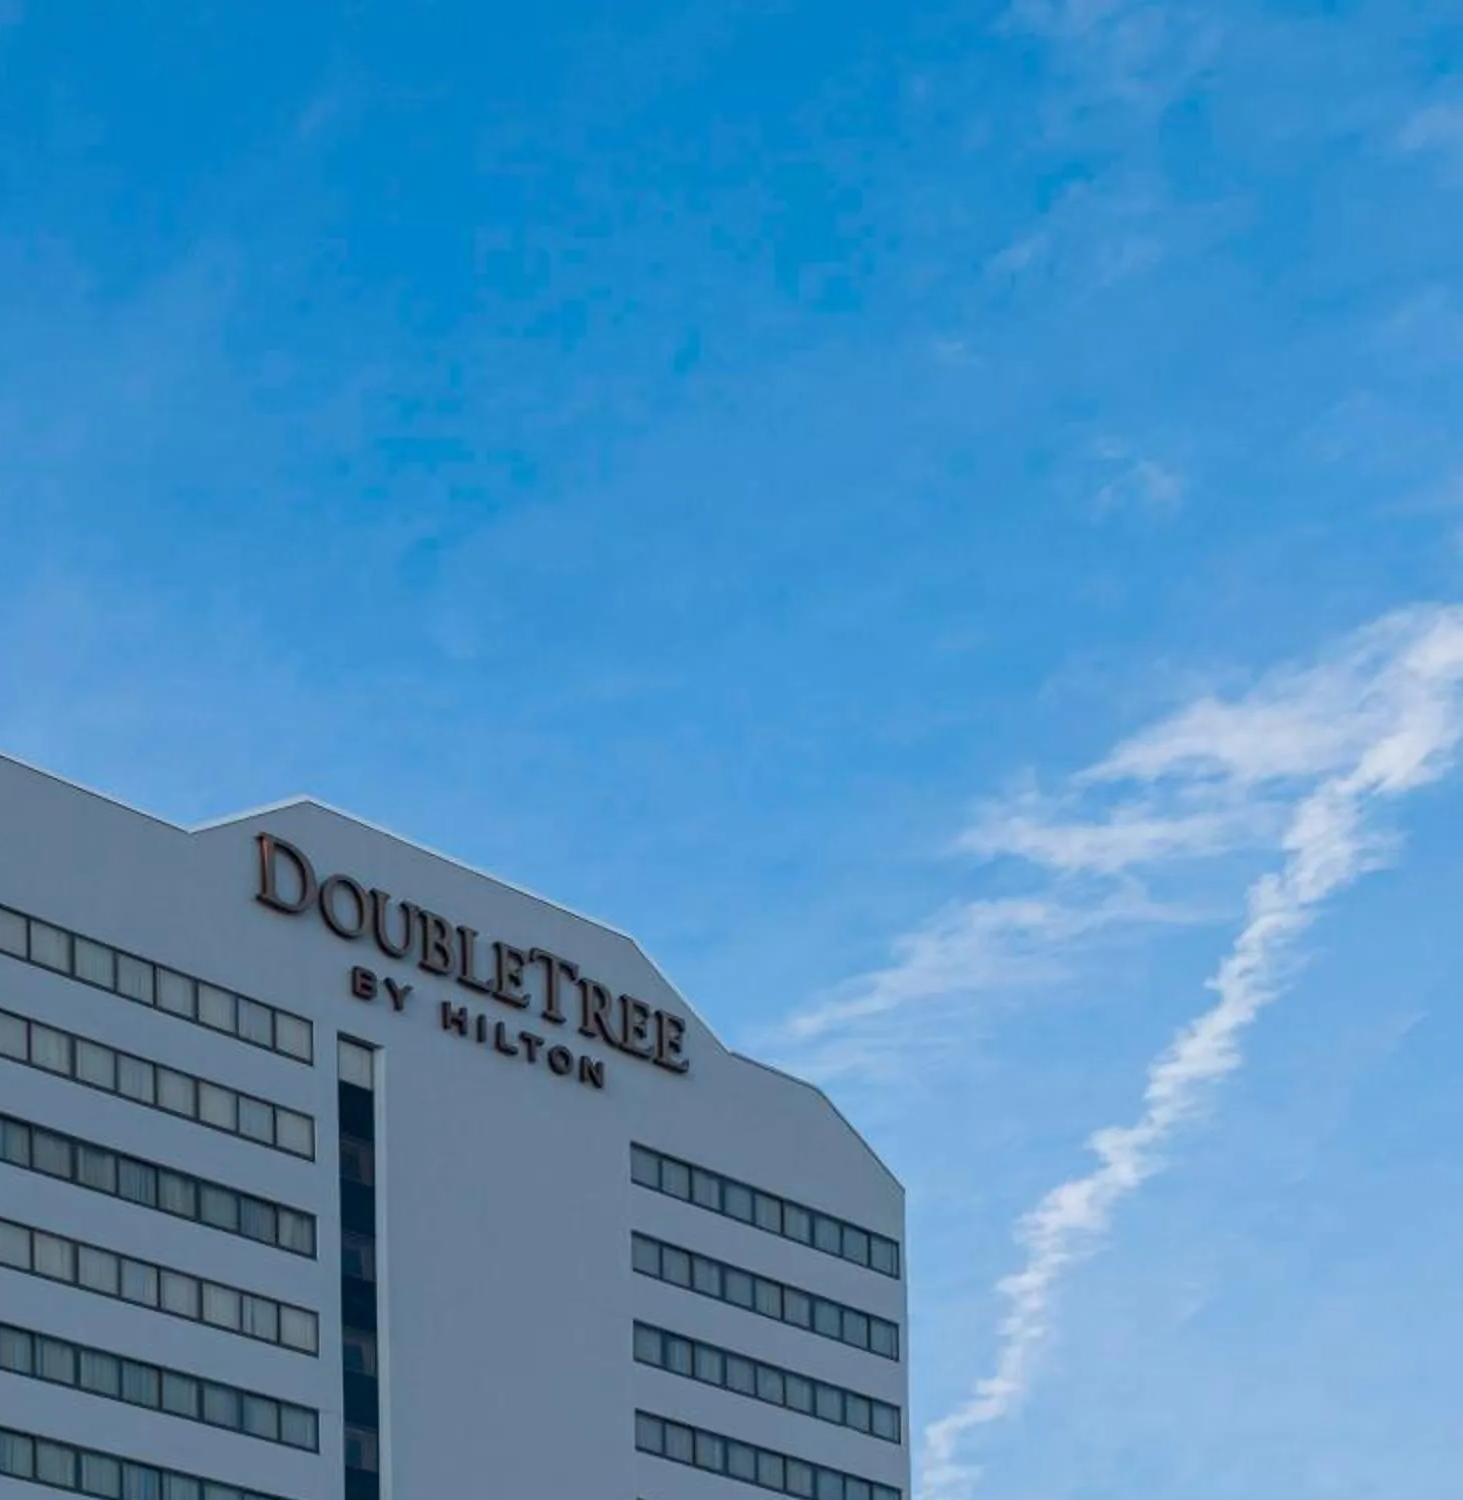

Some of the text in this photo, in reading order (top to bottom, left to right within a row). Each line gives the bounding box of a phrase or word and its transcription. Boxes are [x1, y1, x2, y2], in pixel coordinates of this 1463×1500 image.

[254, 831, 690, 1075] DOUBLETREE
[350, 964, 606, 1090] BY HILTON
